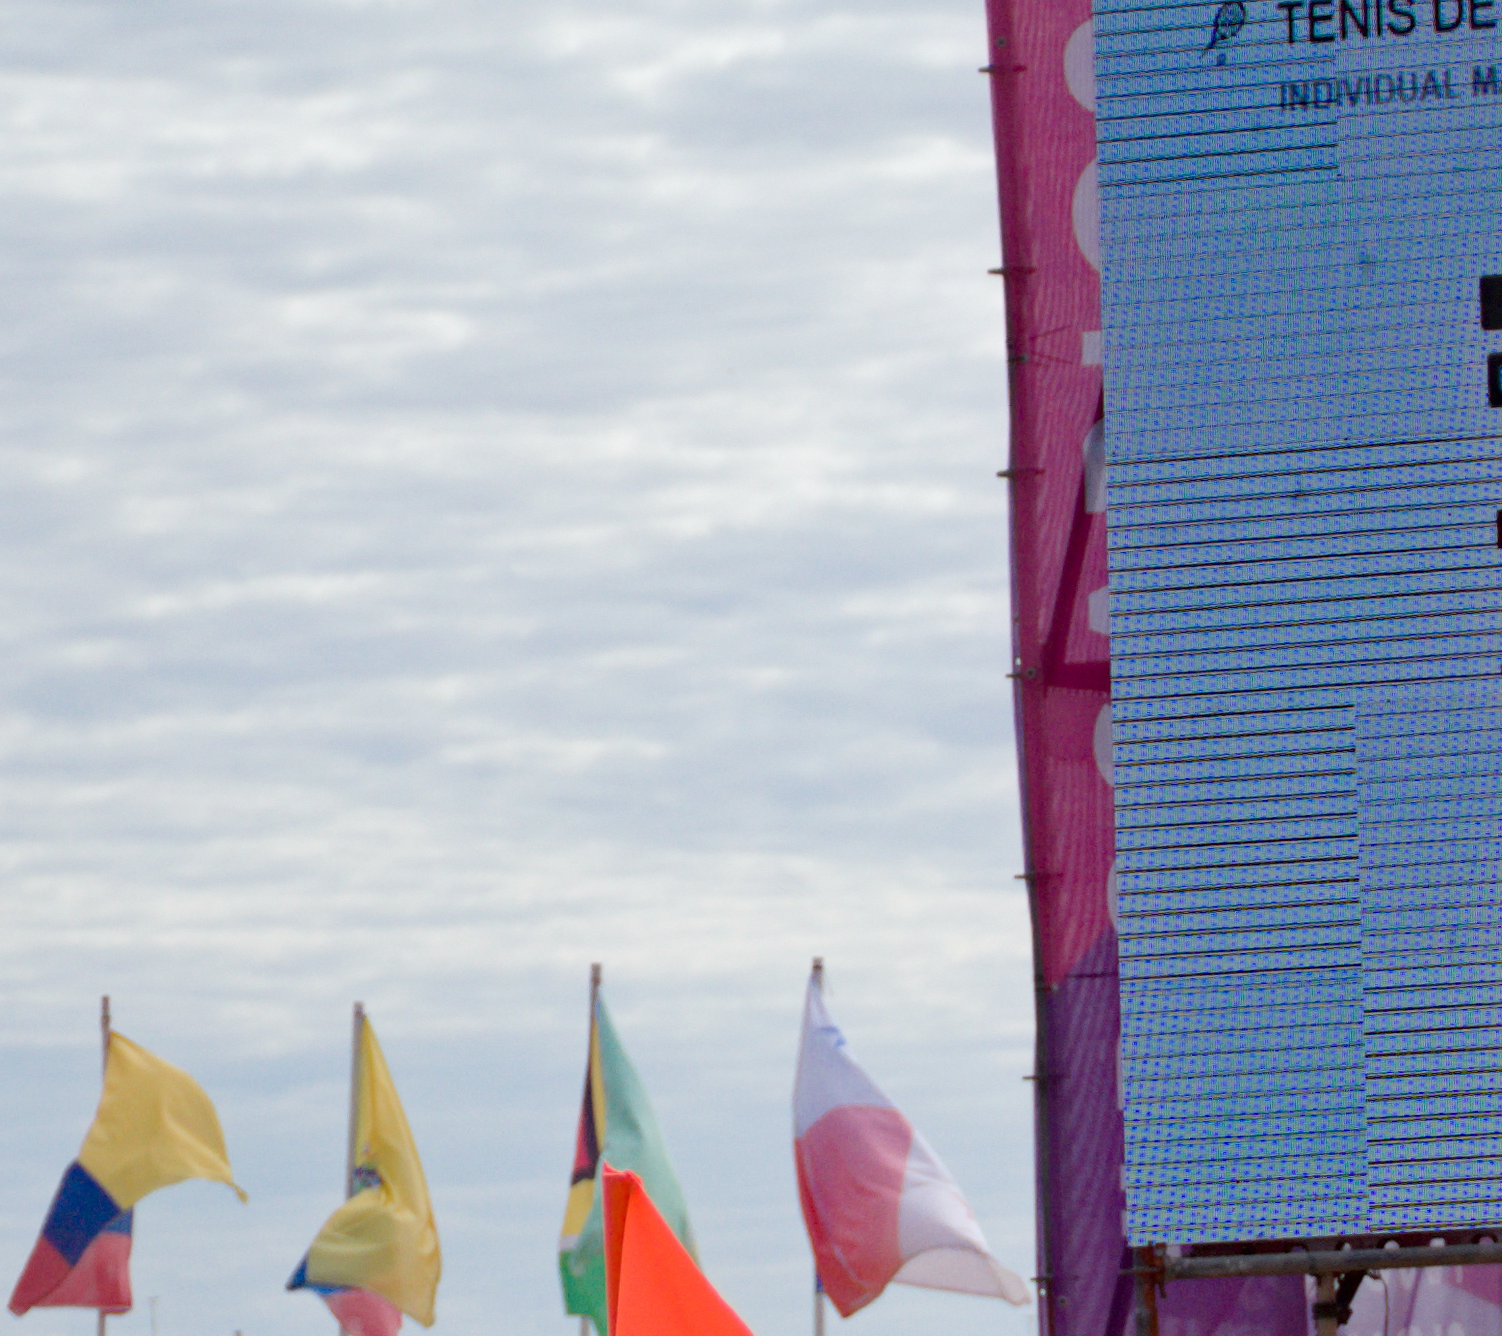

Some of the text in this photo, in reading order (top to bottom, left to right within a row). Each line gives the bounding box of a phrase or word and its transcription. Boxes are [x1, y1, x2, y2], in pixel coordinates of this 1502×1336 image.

[1275, 0, 1416, 44] TENIS
[1430, 0, 1497, 34] DE
[1278, 70, 1462, 112] INDIVIDUAL
